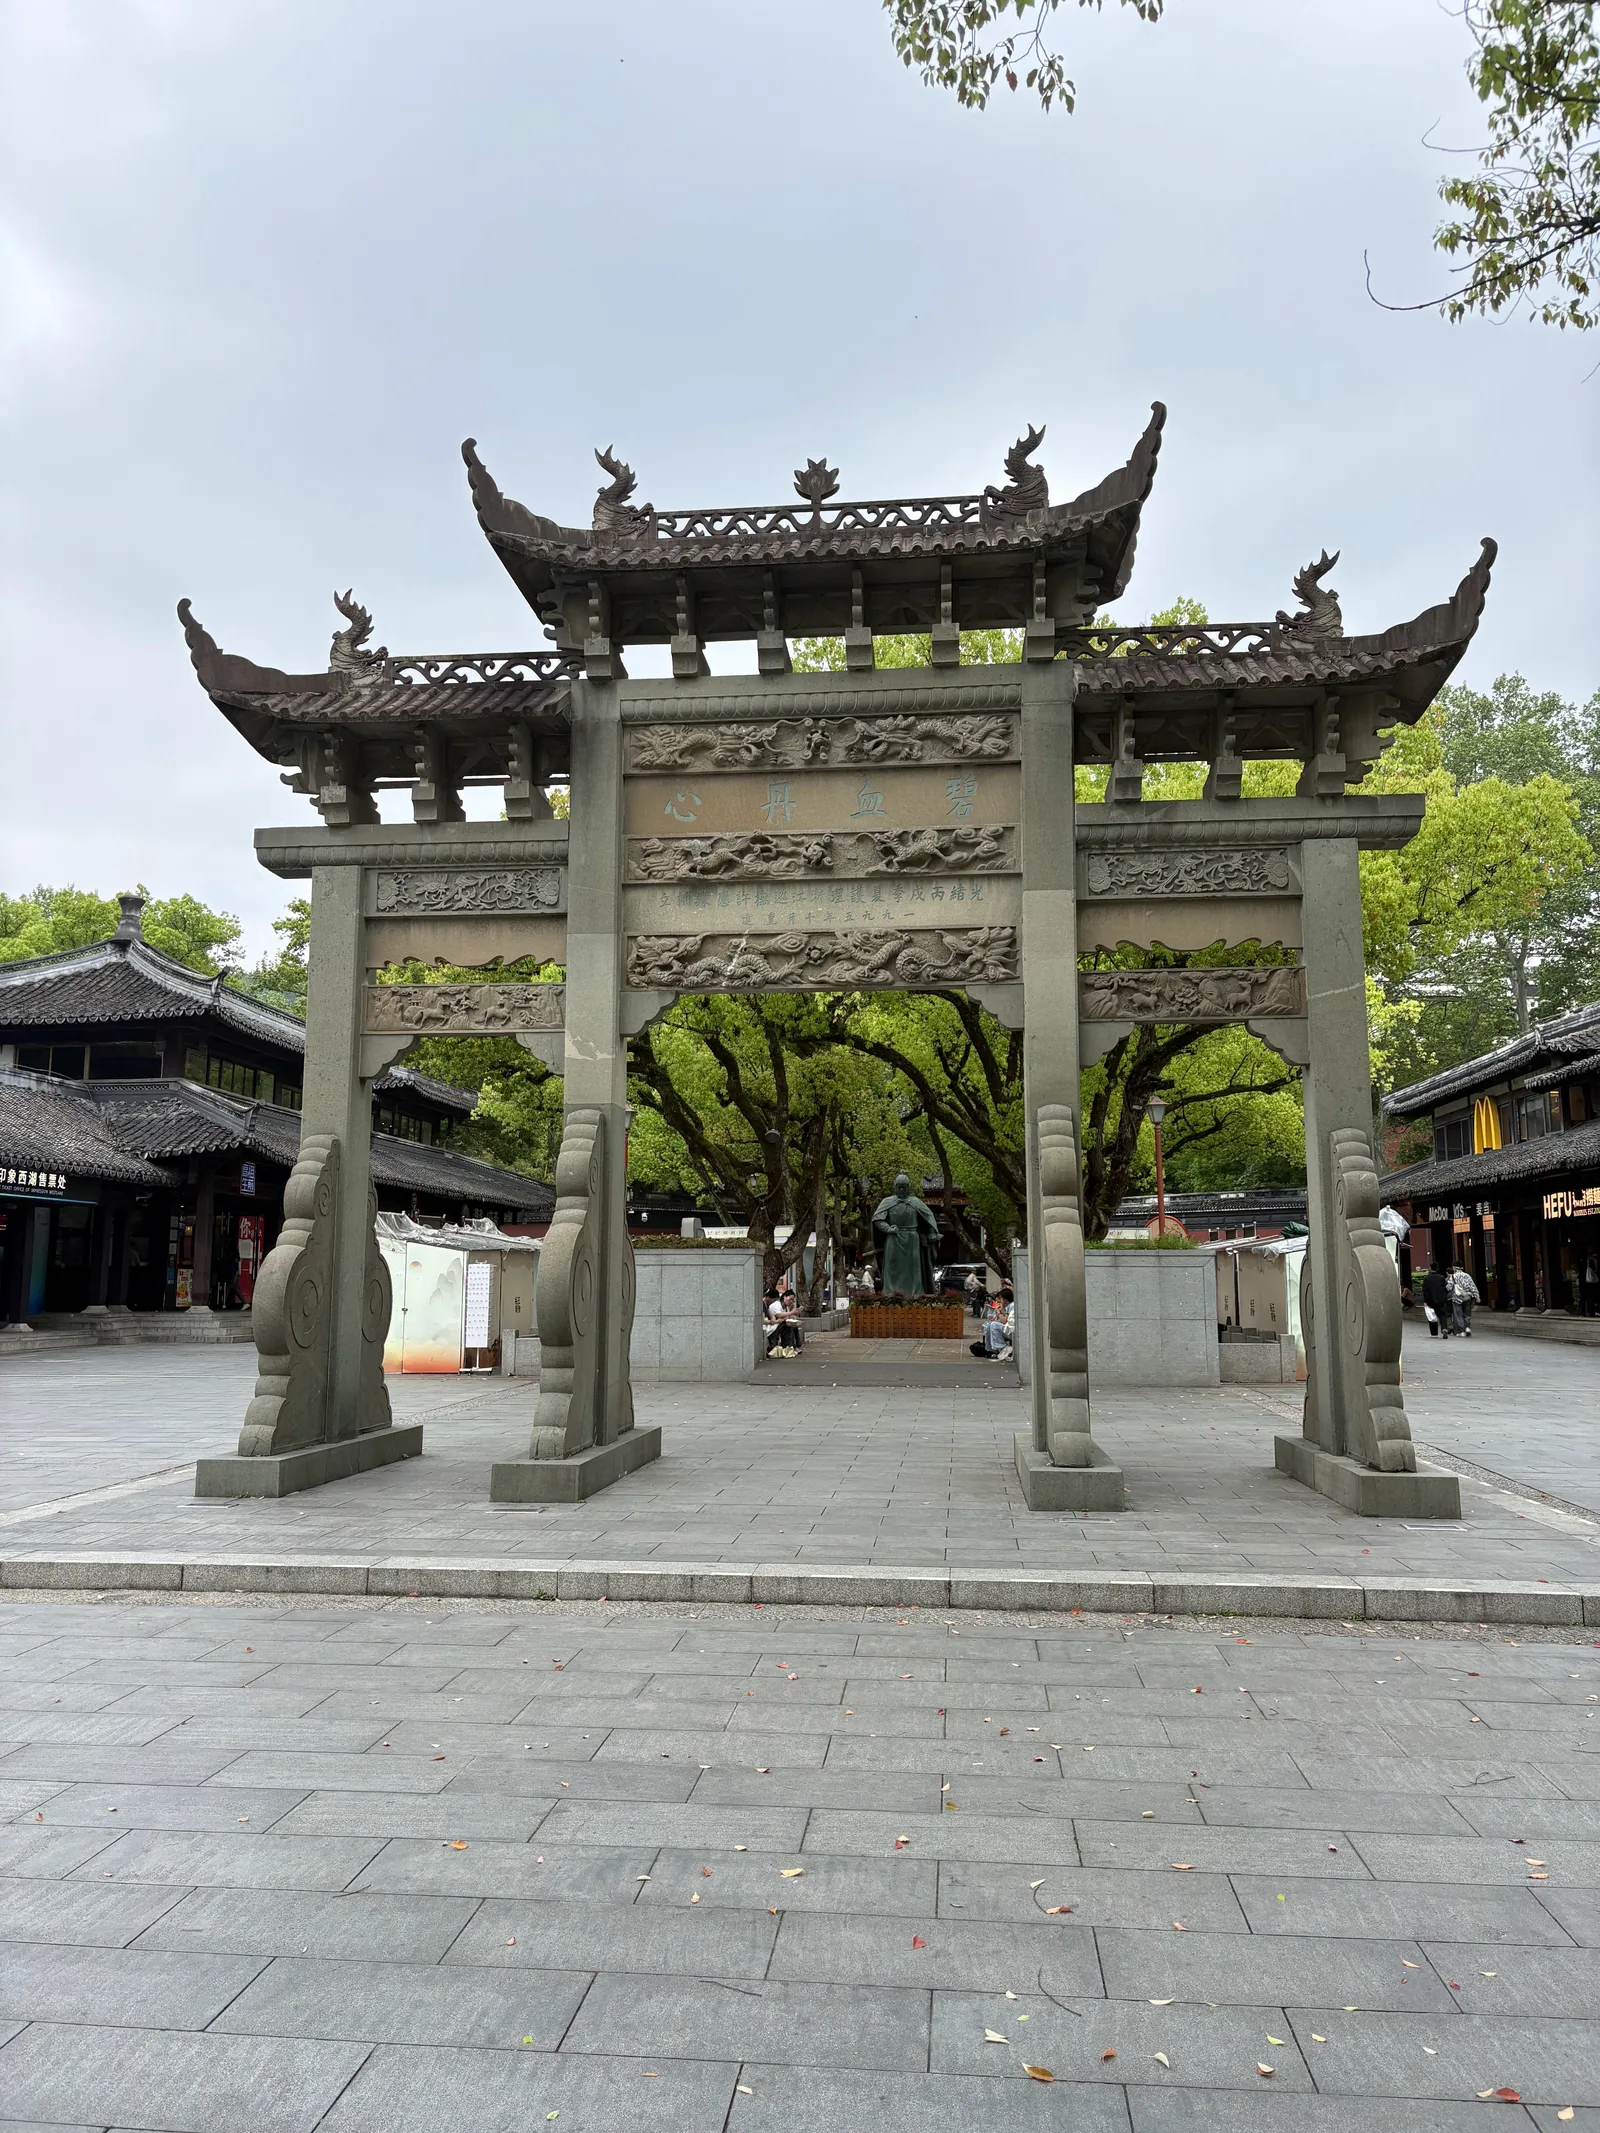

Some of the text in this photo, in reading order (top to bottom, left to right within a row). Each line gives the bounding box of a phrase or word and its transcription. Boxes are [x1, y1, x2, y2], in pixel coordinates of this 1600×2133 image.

[664, 773, 978, 823] 碧血丹心
[0, 1168, 66, 1189] 印象西湖售票处
[1543, 1191, 1572, 1219] HEFU
